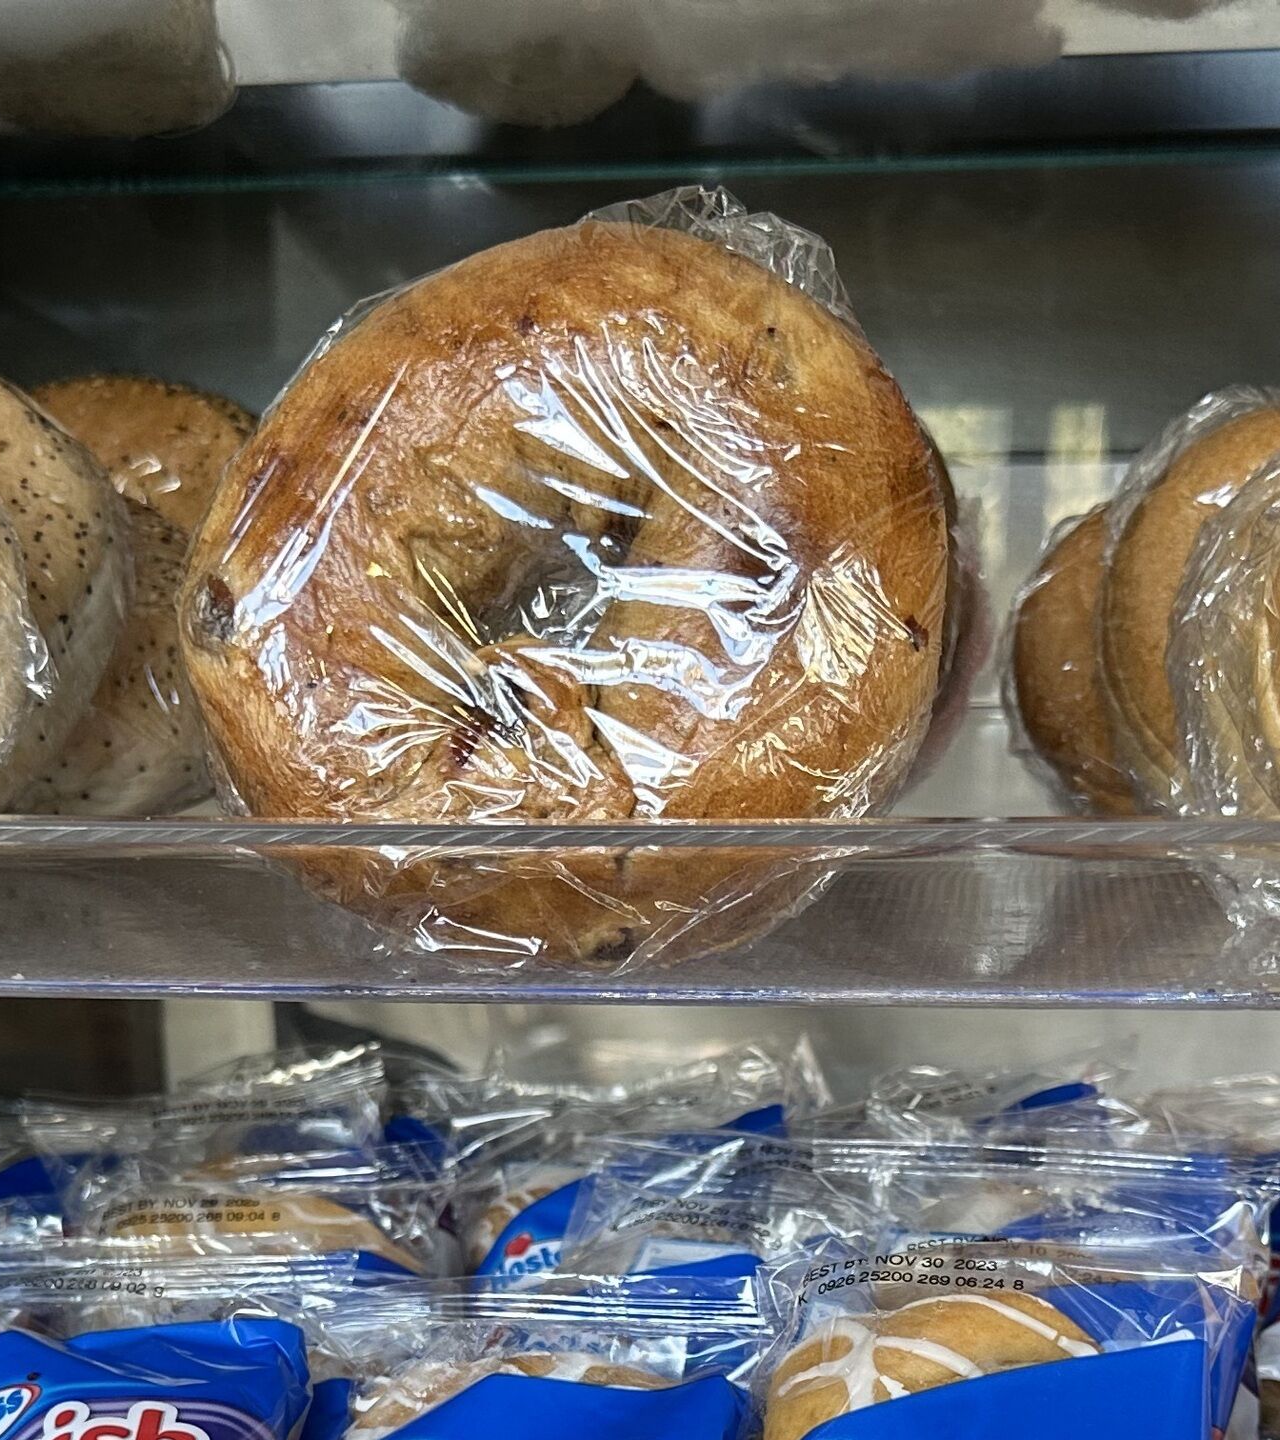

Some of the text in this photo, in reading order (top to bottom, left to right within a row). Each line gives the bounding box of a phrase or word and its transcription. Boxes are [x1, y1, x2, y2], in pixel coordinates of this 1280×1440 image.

[875, 1255, 917, 1268] NOV
[922, 1257, 944, 1269] 30
[954, 1259, 999, 1272] 2023
[818, 1274, 856, 1296] 0926
[859, 1271, 914, 1284] 25200
[916, 1273, 951, 1287] 269
[1013, 1278, 1025, 1291] 8
